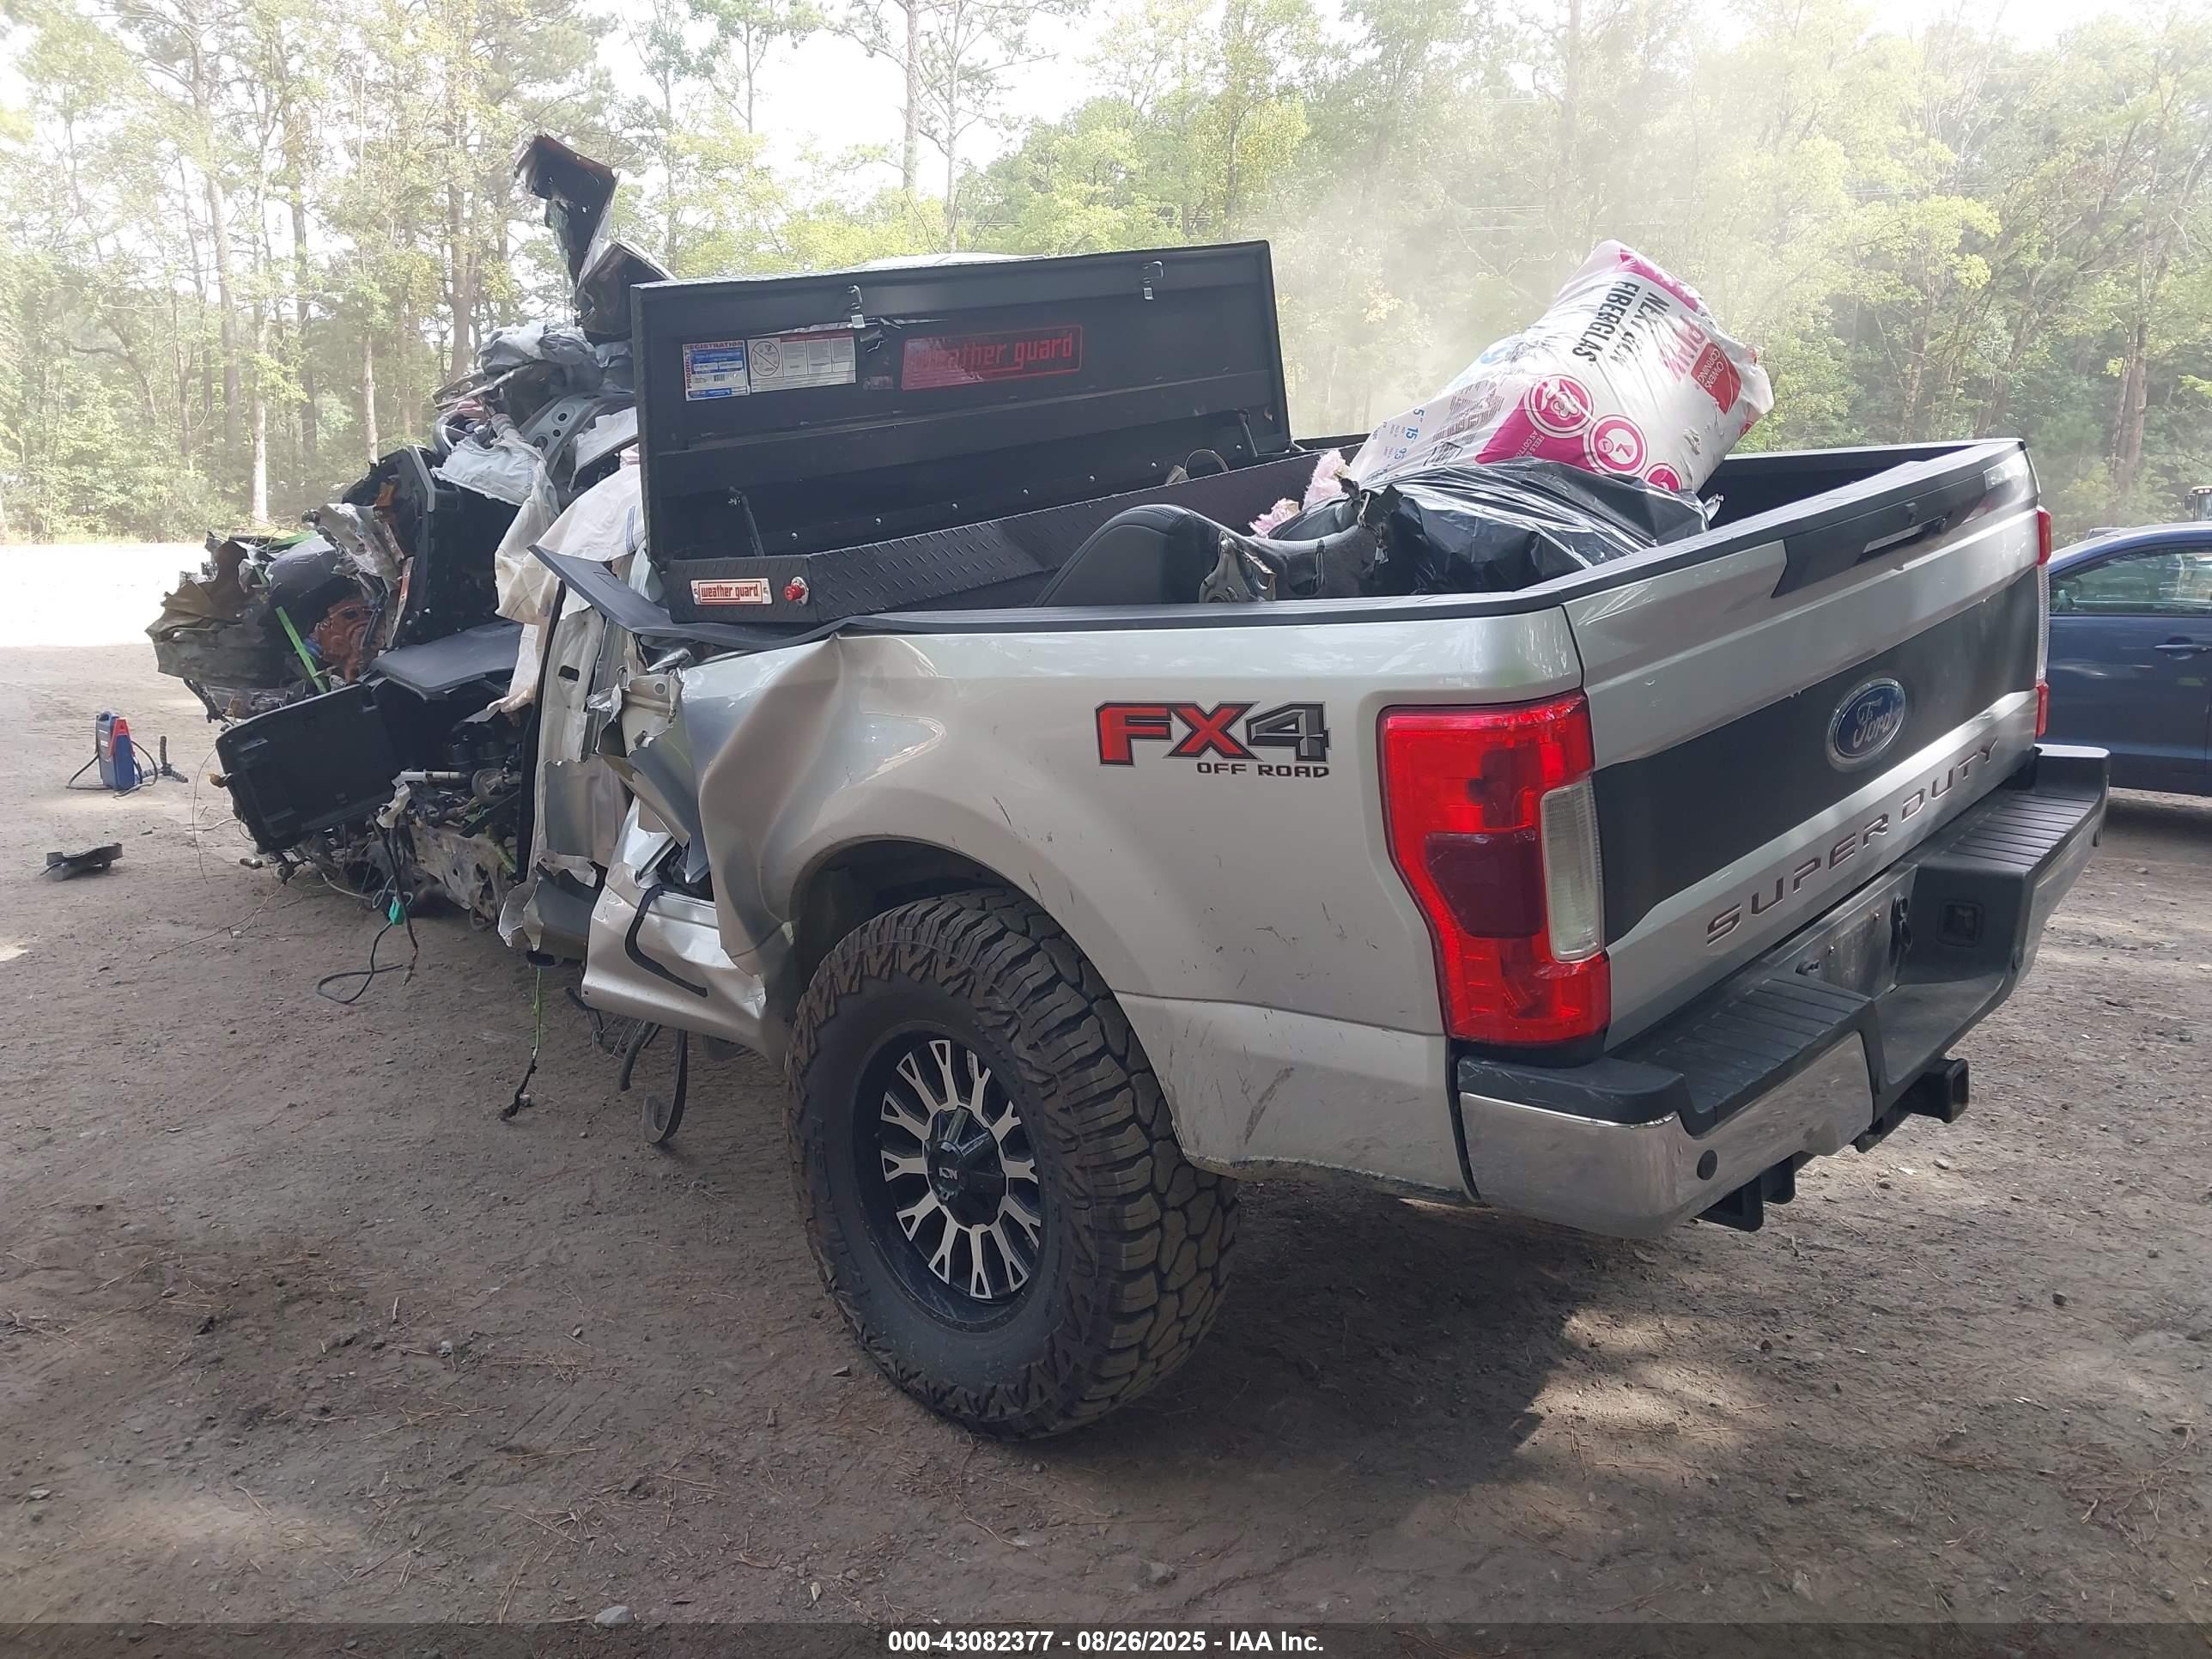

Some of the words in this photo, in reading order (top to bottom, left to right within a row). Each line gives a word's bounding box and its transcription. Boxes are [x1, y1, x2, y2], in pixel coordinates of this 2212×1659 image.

[1014, 331, 1073, 370] guard
[1697, 348, 1721, 383] CORNING
[1705, 361, 1724, 390] OWENS
[1516, 438, 1533, 458] COTTO
[701, 585, 732, 598] weather
[735, 583, 759, 600] guard
[1096, 702, 1332, 767] FX4
[1852, 696, 1894, 749] Ford
[1197, 762, 1248, 775] OFF
[1257, 764, 1330, 778] ROAD
[1706, 812, 1889, 945] SUPER
[1900, 735, 1998, 823] DUTY
